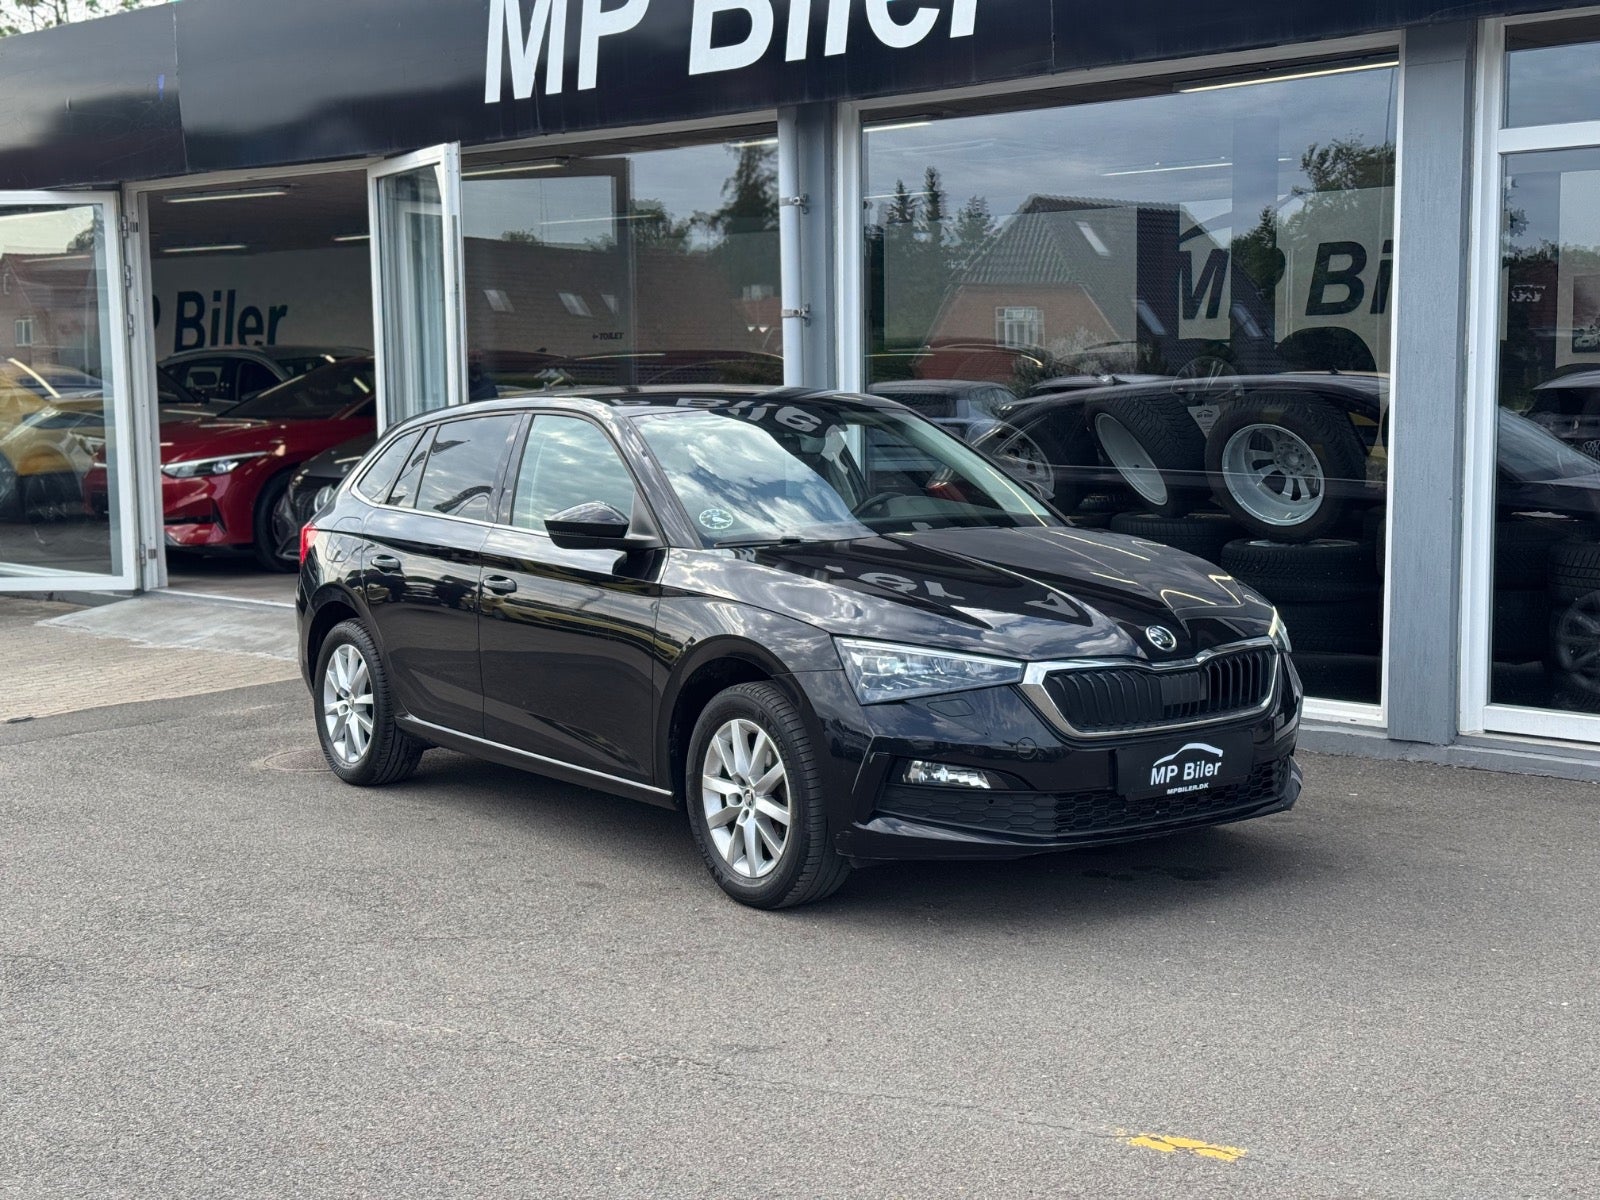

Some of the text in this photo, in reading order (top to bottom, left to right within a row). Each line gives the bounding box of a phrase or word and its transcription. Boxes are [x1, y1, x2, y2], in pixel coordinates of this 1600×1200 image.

[484, 0, 650, 104] MP
[174, 289, 288, 353] Biler
[1150, 760, 1222, 786] MP Biler
[1166, 782, 1209, 795] MPBILER.DK
